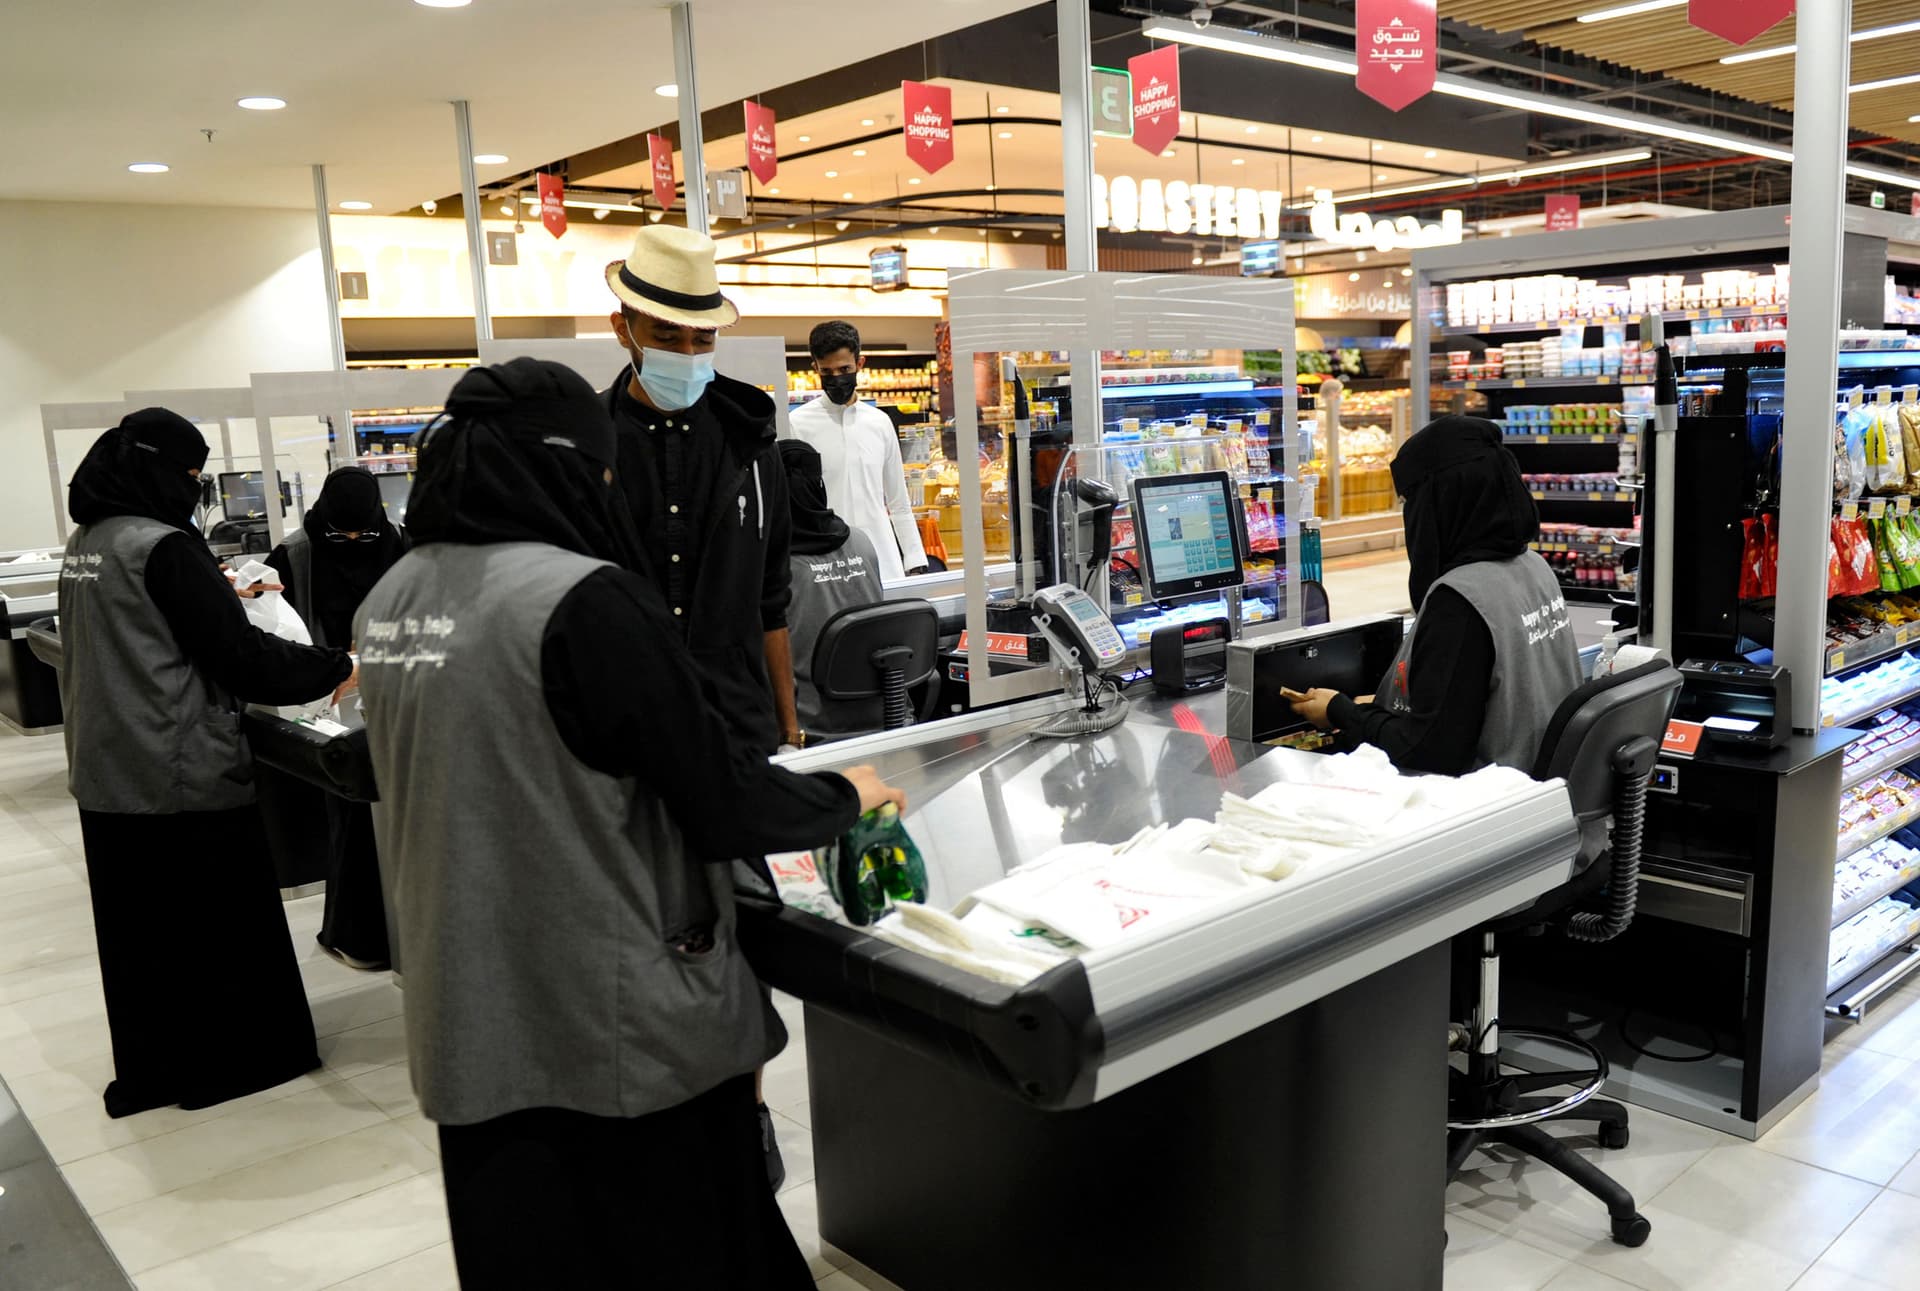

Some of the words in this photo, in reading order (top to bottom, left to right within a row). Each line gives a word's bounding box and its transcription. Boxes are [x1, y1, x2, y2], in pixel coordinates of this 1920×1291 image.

[1373, 28, 1420, 44] تسوق
[1369, 48, 1423, 61] سعيد
[1140, 84, 1168, 102] HAPPY
[1134, 96, 1176, 118] SHOPPING
[914, 113, 942, 127] HAPPY
[908, 125, 950, 139] SHOPPING
[810, 562, 833, 573] happy
[836, 560, 846, 568] to
[848, 555, 863, 566] help
[1541, 604, 1550, 617] to
